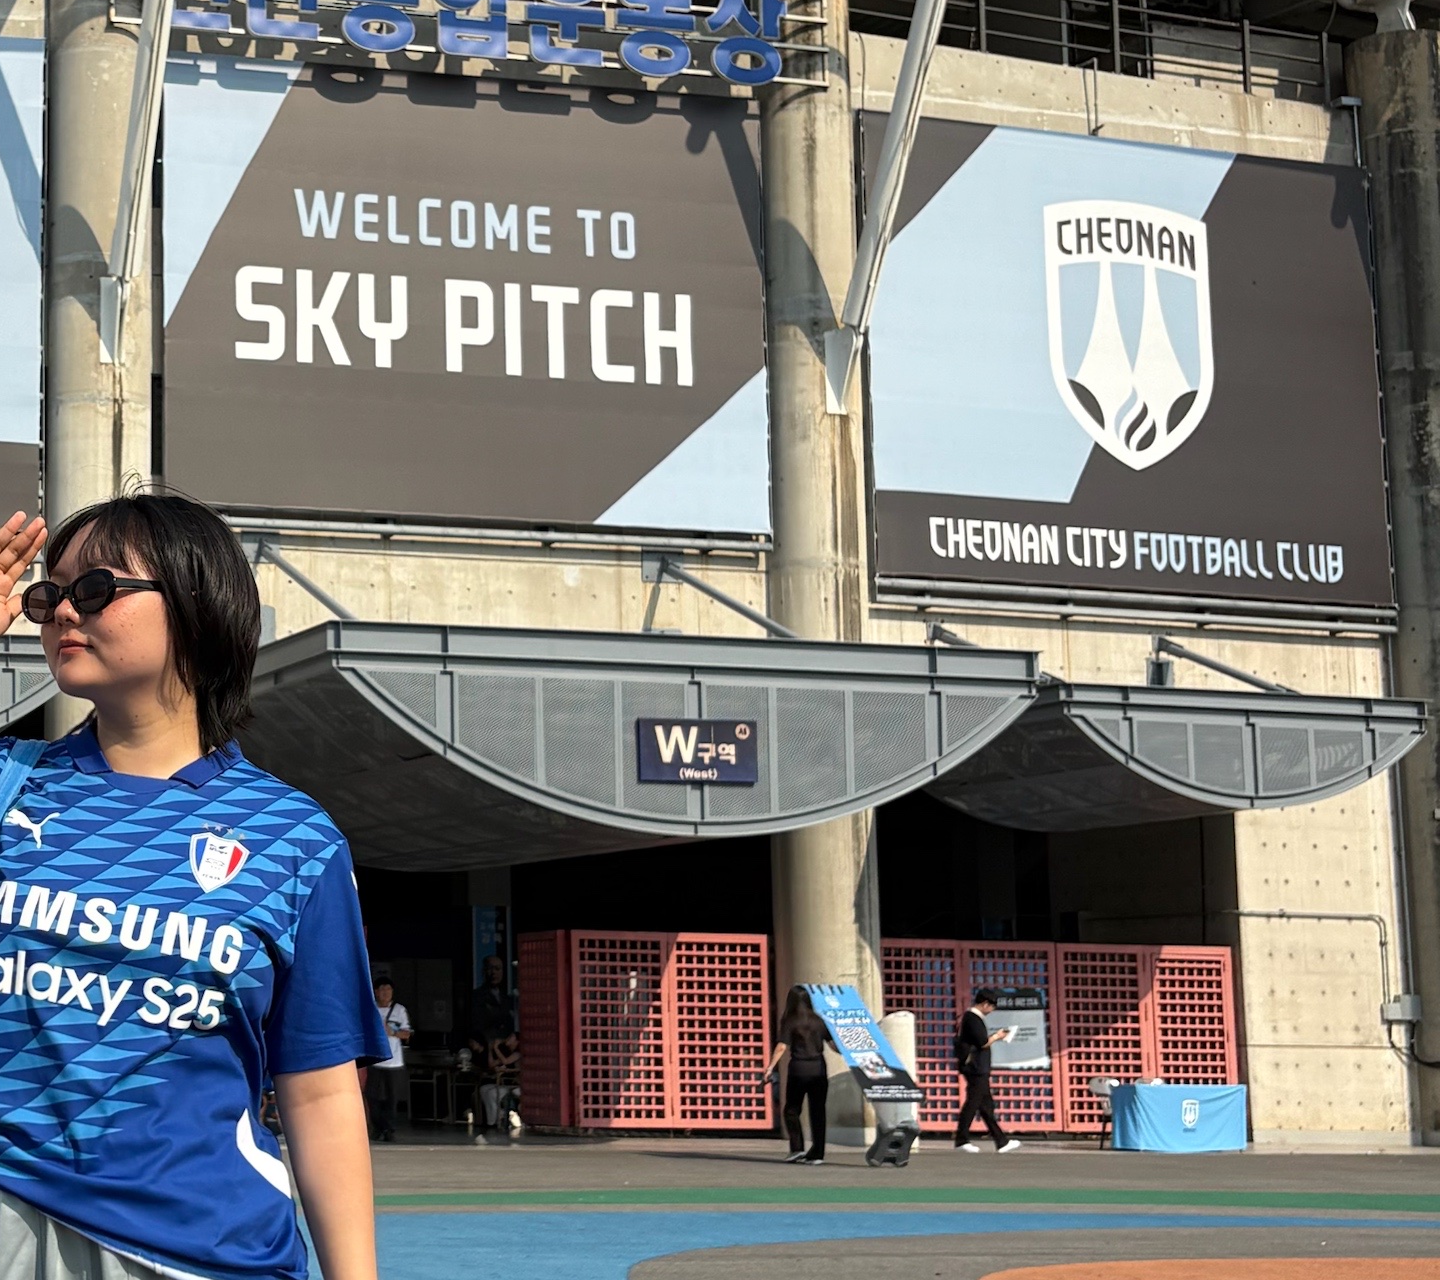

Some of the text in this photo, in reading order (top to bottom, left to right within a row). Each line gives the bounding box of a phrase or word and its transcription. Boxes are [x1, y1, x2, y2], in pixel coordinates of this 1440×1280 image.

[294, 188, 637, 260] WELCOME TO
[1056, 216, 1197, 272] CHEONAN
[234, 265, 694, 387] SKY PITCH
[928, 516, 1344, 585] CHEONAN CITY FOOTBALL CLUB
[653, 724, 737, 765] W구역
[136, 977, 227, 1031] S25
